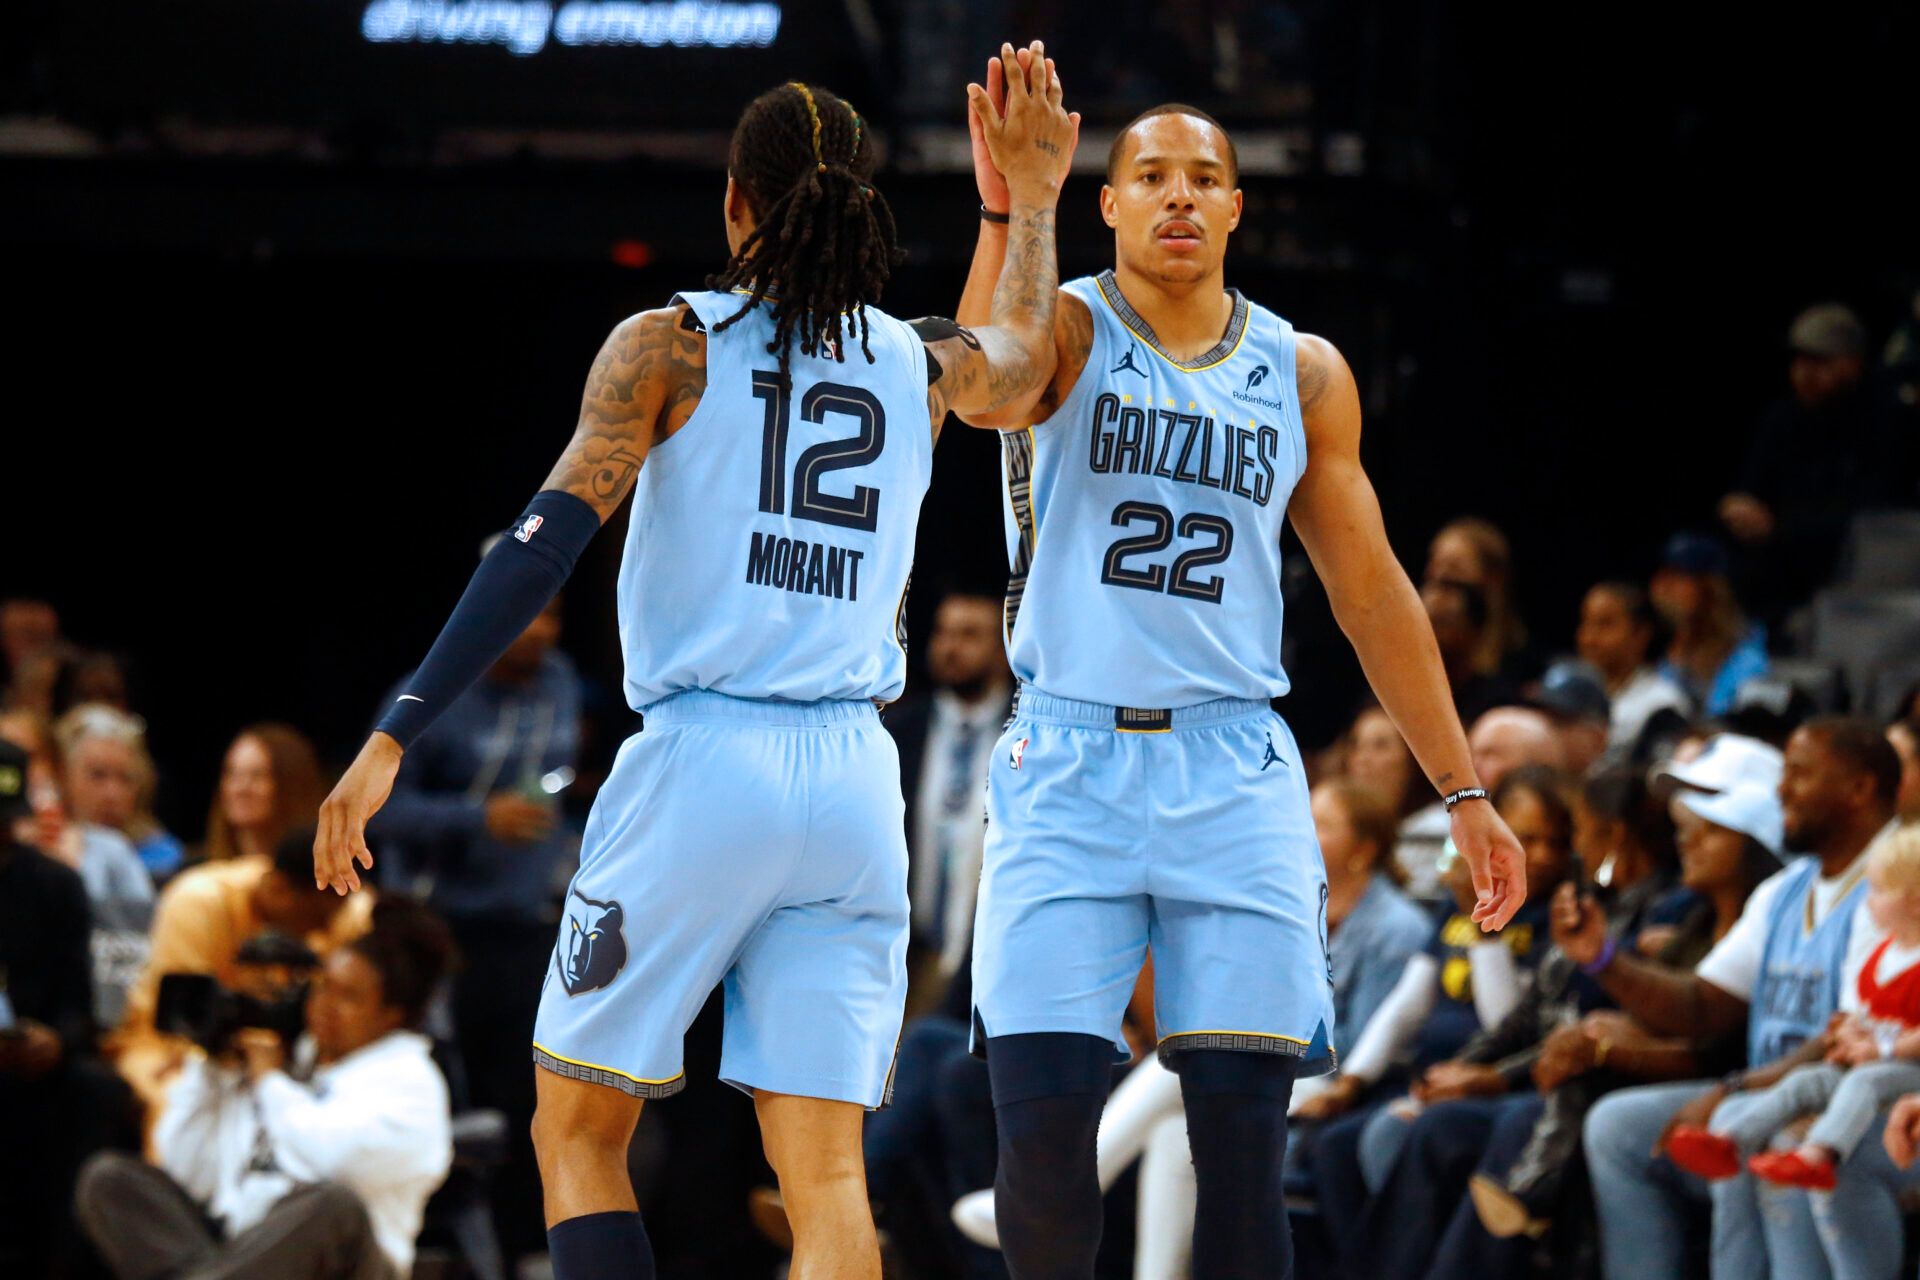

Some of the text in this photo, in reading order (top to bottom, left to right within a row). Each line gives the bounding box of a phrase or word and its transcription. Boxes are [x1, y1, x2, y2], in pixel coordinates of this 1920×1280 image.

[751, 369, 886, 533] 12
[1089, 392, 1279, 508] GRIZZLIES
[1232, 391, 1282, 411] Robinhood
[746, 531, 864, 602] MORANT
[1100, 500, 1234, 605] 22
